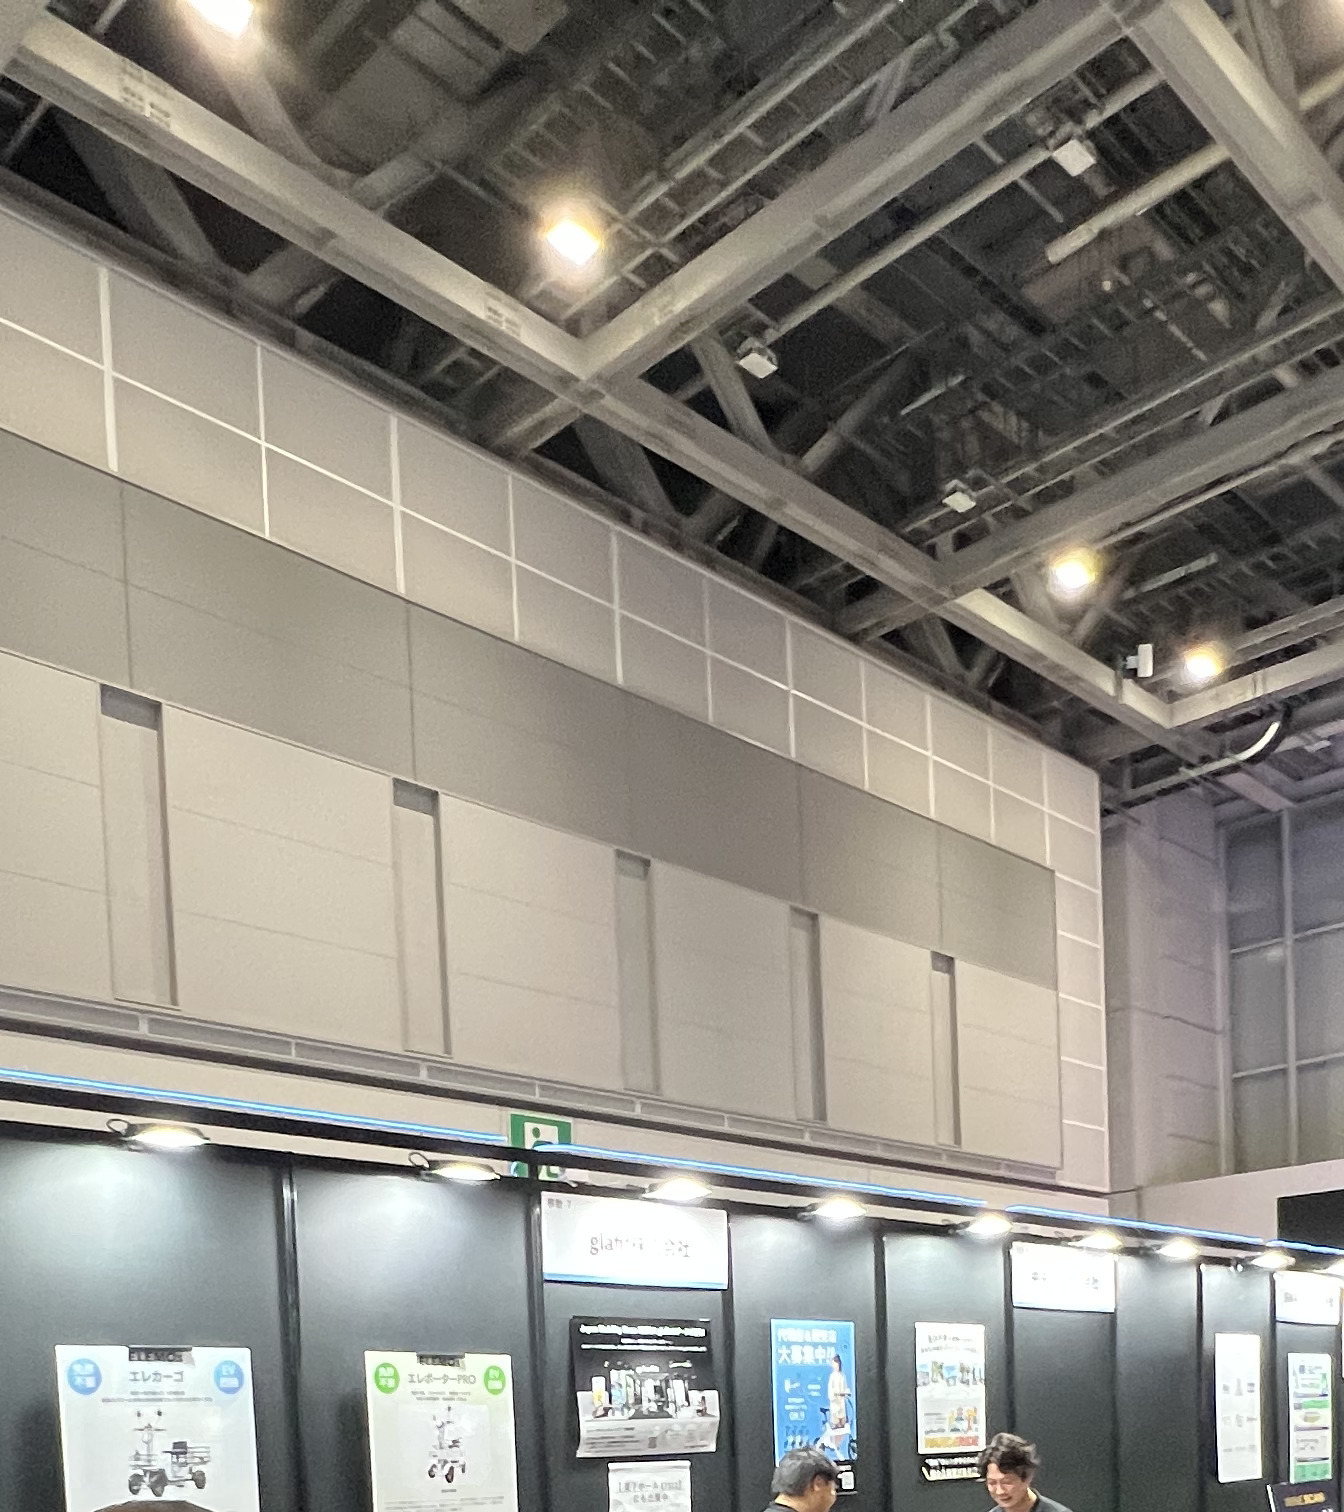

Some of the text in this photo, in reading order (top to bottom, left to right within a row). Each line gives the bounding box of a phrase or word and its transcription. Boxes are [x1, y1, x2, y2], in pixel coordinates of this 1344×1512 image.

[129, 1371, 184, 1383] エレカーゴ
